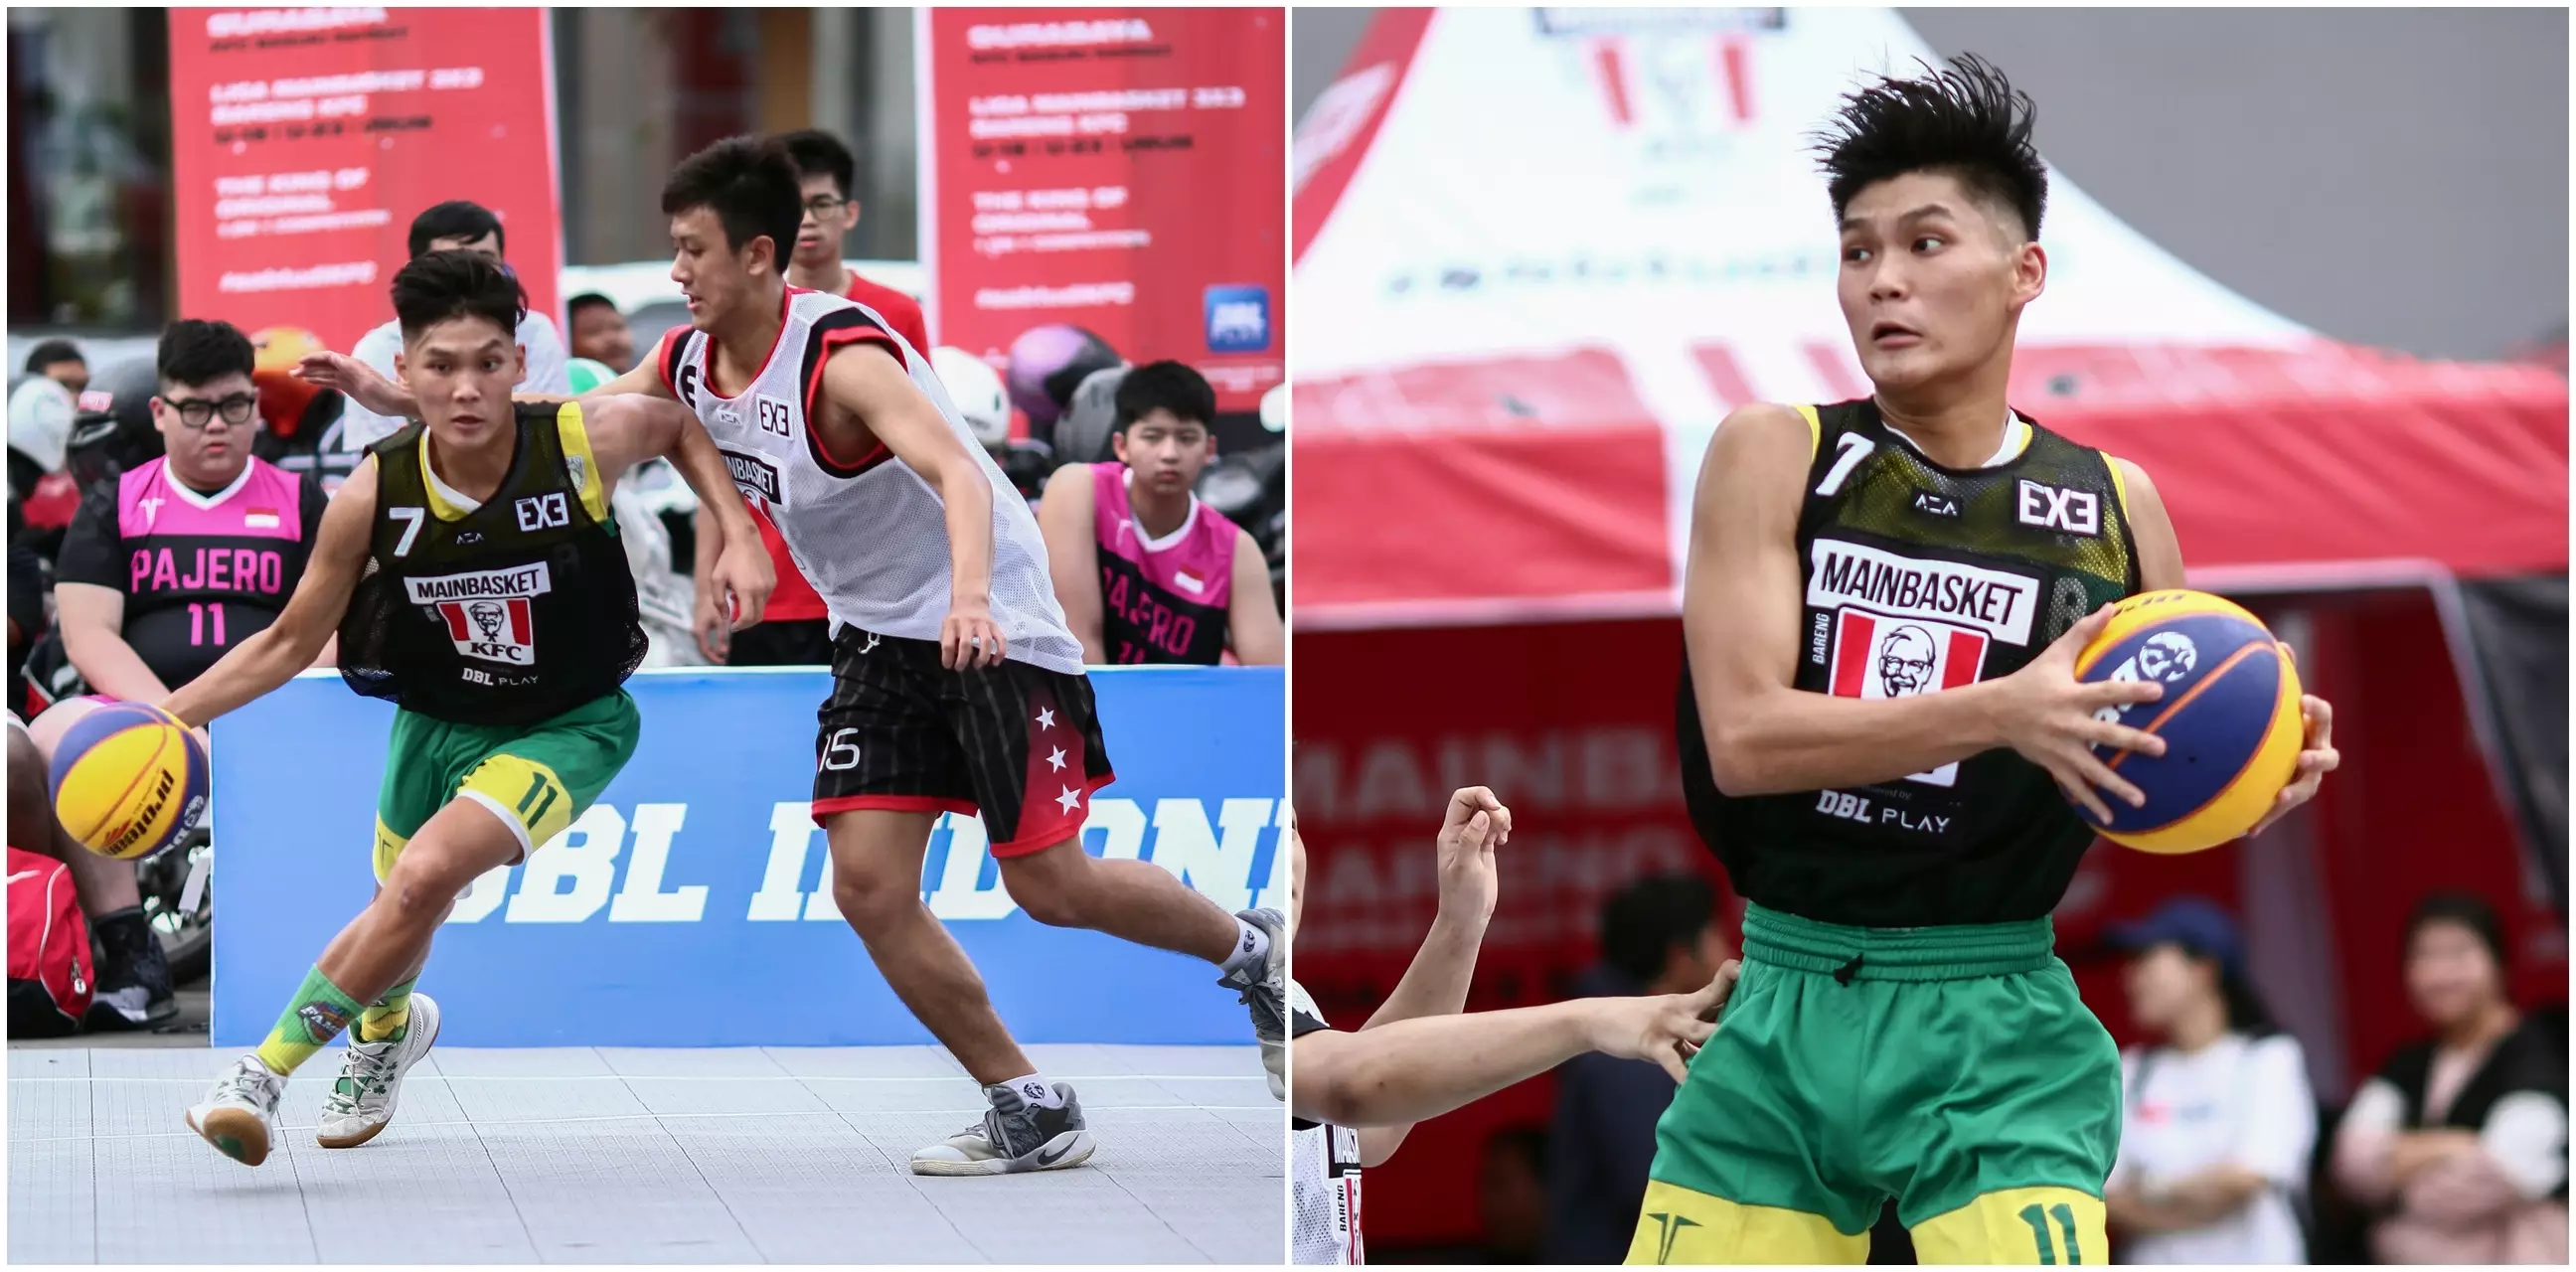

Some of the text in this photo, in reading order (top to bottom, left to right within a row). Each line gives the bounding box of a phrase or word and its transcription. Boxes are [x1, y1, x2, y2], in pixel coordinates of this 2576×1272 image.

[1816, 431, 1877, 496] 7
[389, 507, 425, 557] 7
[130, 548, 282, 594] PAJERO
[416, 568, 540, 598] MAINBASKET
[1820, 552, 2023, 626] MAINBASKET
[187, 601, 227, 647] 11
[1812, 612, 1831, 665] BARENG
[470, 642, 522, 662] KFC
[462, 668, 494, 686] DBL
[499, 675, 539, 686] PLAY
[818, 727, 861, 771] 15
[516, 770, 559, 831] 11
[1816, 788, 1951, 833] DBL PLAY
[2017, 1202, 2083, 1265] 11
